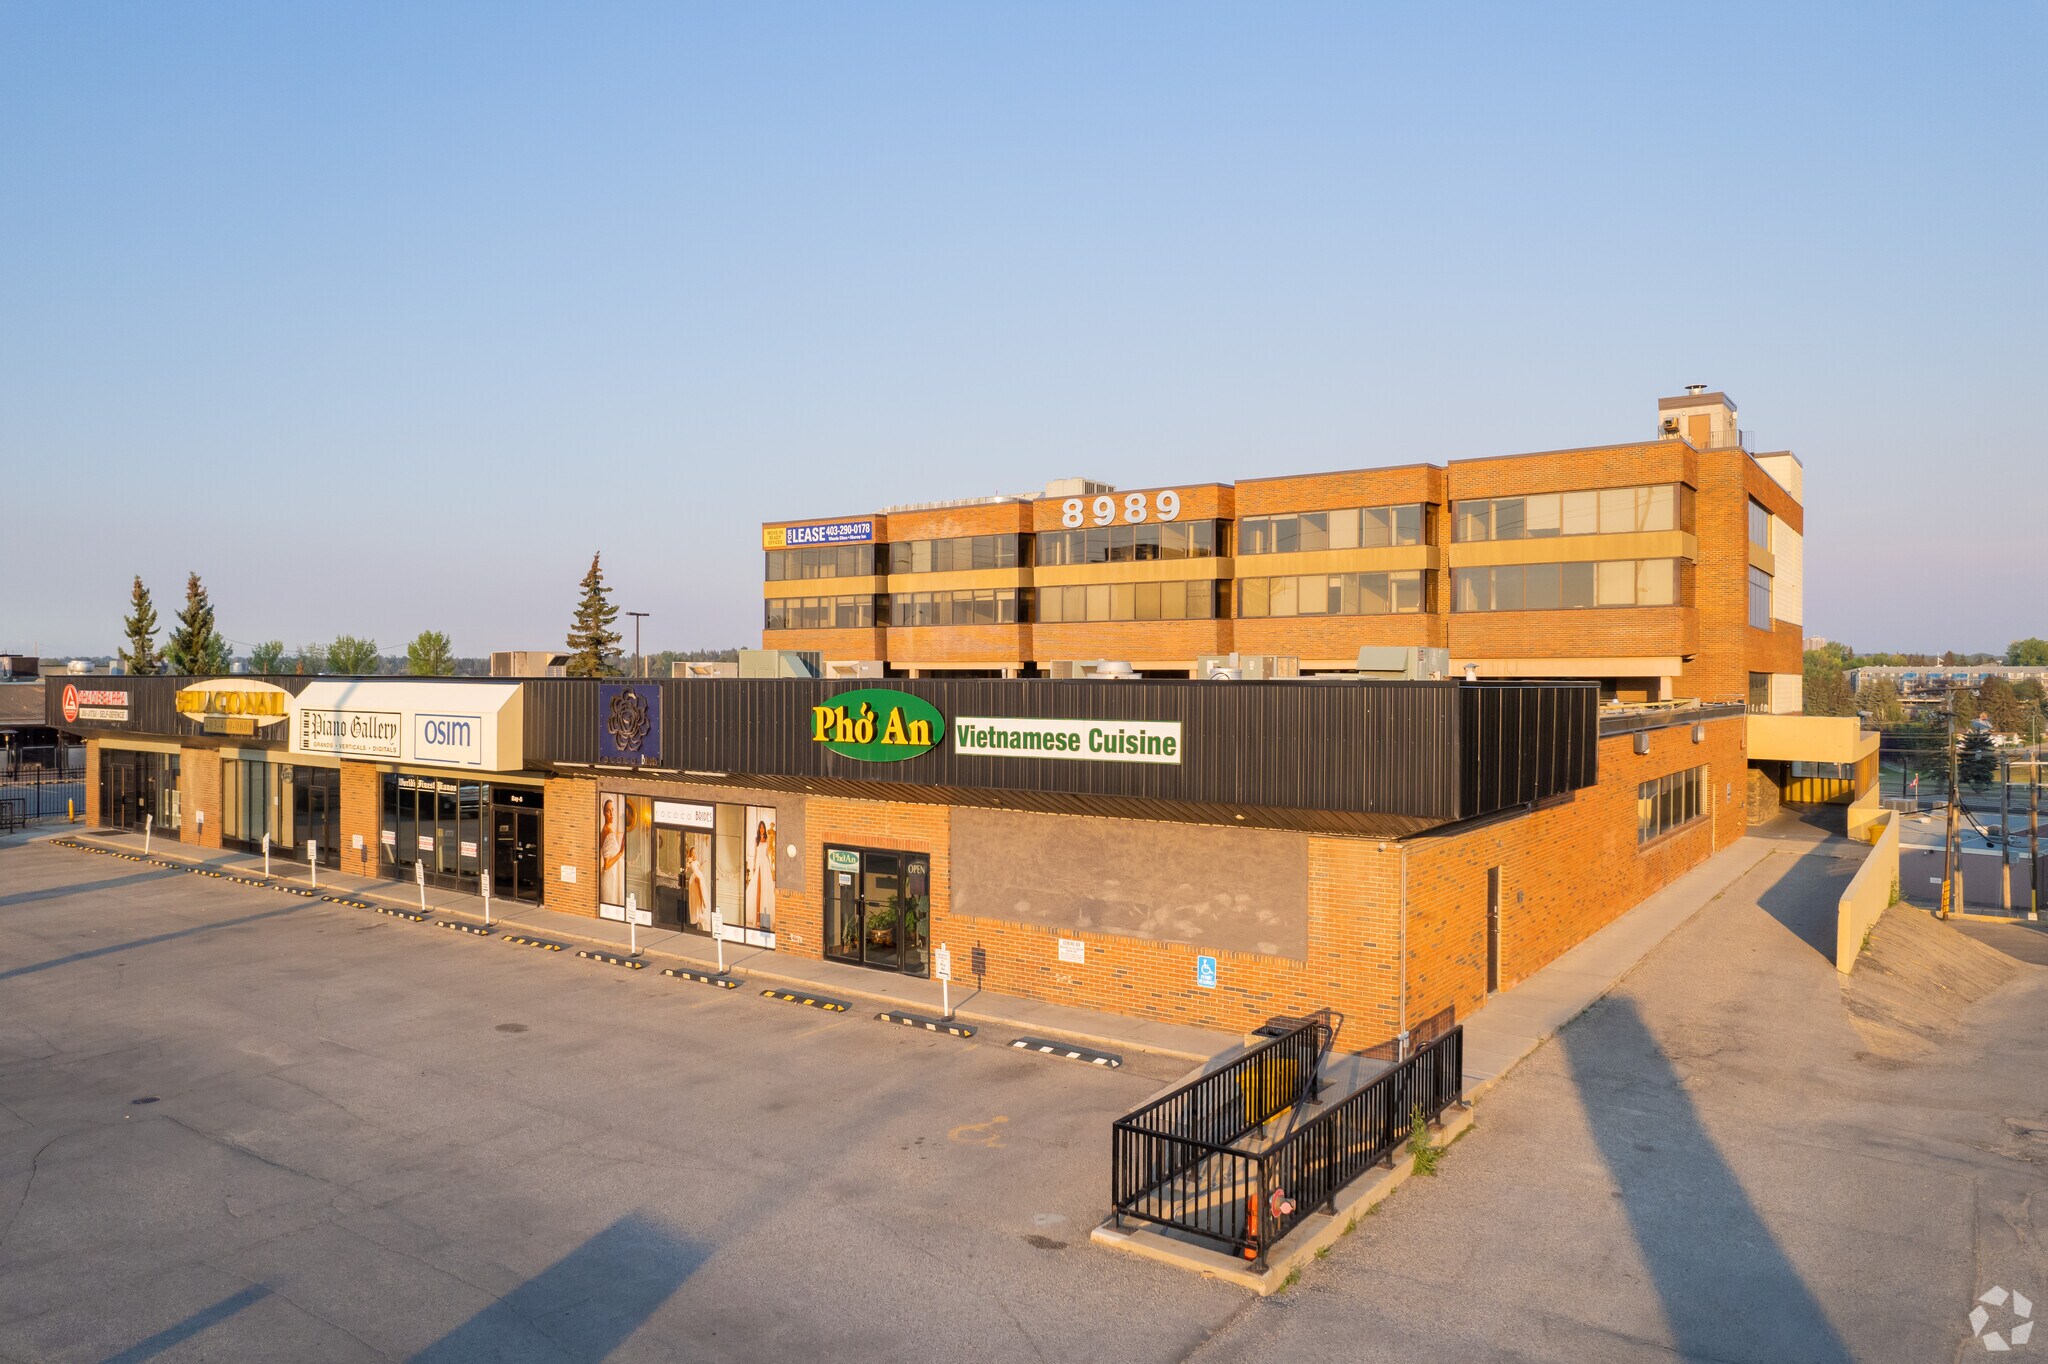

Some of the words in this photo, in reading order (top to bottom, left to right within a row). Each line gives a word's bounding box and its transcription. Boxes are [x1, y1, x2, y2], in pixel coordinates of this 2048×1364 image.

[1062, 490, 1180, 528] 8989
[793, 527, 826, 543] LEASE
[825, 523, 871, 536] 403-290-0178
[311, 712, 347, 740] Piano
[350, 715, 398, 745] Gallery
[812, 702, 876, 744] Phở
[881, 706, 932, 746] An
[313, 741, 334, 749] GRANDS
[339, 743, 367, 751] VERTICALS
[372, 745, 398, 753] DIGITALS
[956, 724, 1081, 752] Vietnamese
[1088, 728, 1177, 757] Cuisine
[417, 779, 436, 790] Finest
[908, 864, 925, 874] OPEN
